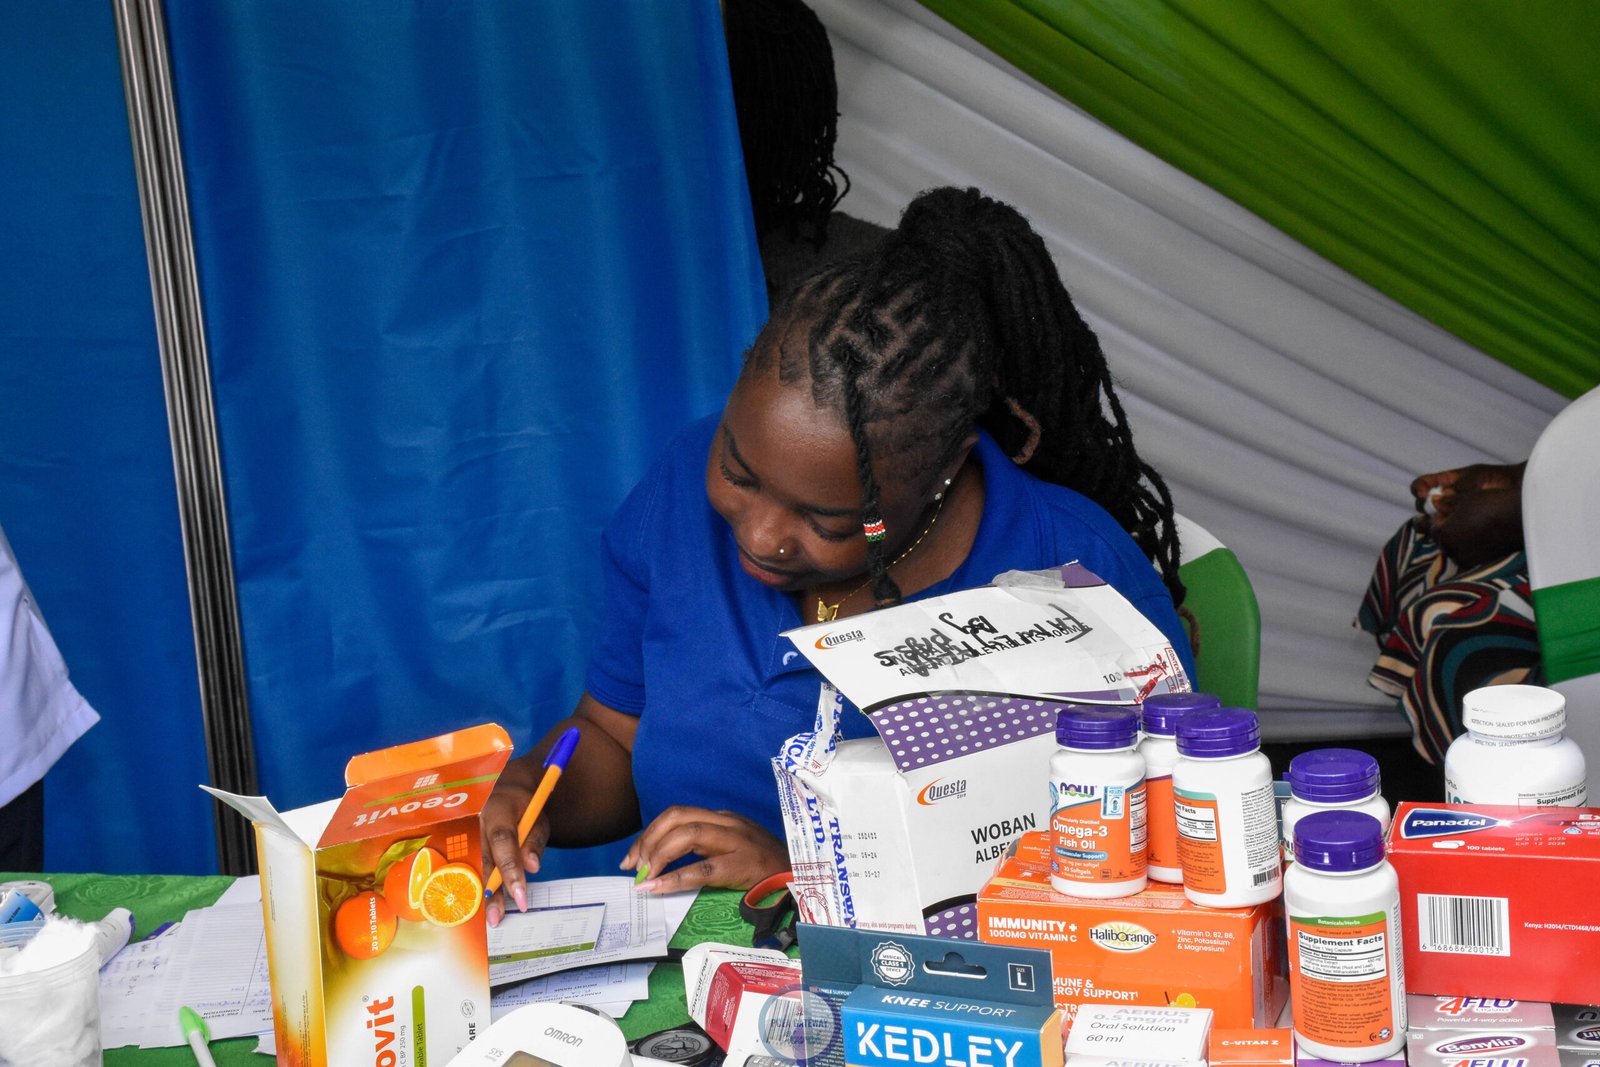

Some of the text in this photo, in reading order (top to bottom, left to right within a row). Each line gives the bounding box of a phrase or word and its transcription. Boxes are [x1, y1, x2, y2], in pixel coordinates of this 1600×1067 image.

[824, 629, 864, 647] Questa
[929, 778, 967, 800] Questa
[1537, 791, 1577, 805] Supplement
[353, 791, 469, 827] Ceovit
[971, 812, 1036, 844] WOBAN
[1053, 820, 1108, 838] Omega-3
[1412, 818, 1486, 827] Panadol
[1059, 836, 1078, 848] Fish
[1080, 840, 1096, 850] Oil
[976, 842, 1010, 864] ALBE
[369, 897, 377, 925] Tablets
[988, 916, 1066, 932] IMMUNITY
[990, 930, 1026, 939] 1000MG
[1028, 932, 1068, 942] VITAMIN
[1177, 929, 1203, 937] Vitamin
[1298, 932, 1382, 946] Supplement Facts
[1194, 938, 1230, 946] Potassium
[1016, 974, 1027, 986] L
[1085, 980, 1094, 988] &
[881, 995, 1016, 1018] KNEE SUPPORT
[1116, 1008, 1192, 1017] AERIUS
[1127, 1016, 1189, 1024] mg/ml
[400, 1025, 406, 1036] mg
[1121, 1023, 1176, 1032] Solution
[544, 1027, 583, 1047] OMRON
[1086, 1034, 1124, 1043] 60 ml
[857, 1022, 1024, 1067] KEDLEY
[1444, 1038, 1517, 1052] Benylin
[488, 1048, 504, 1057] SYS
